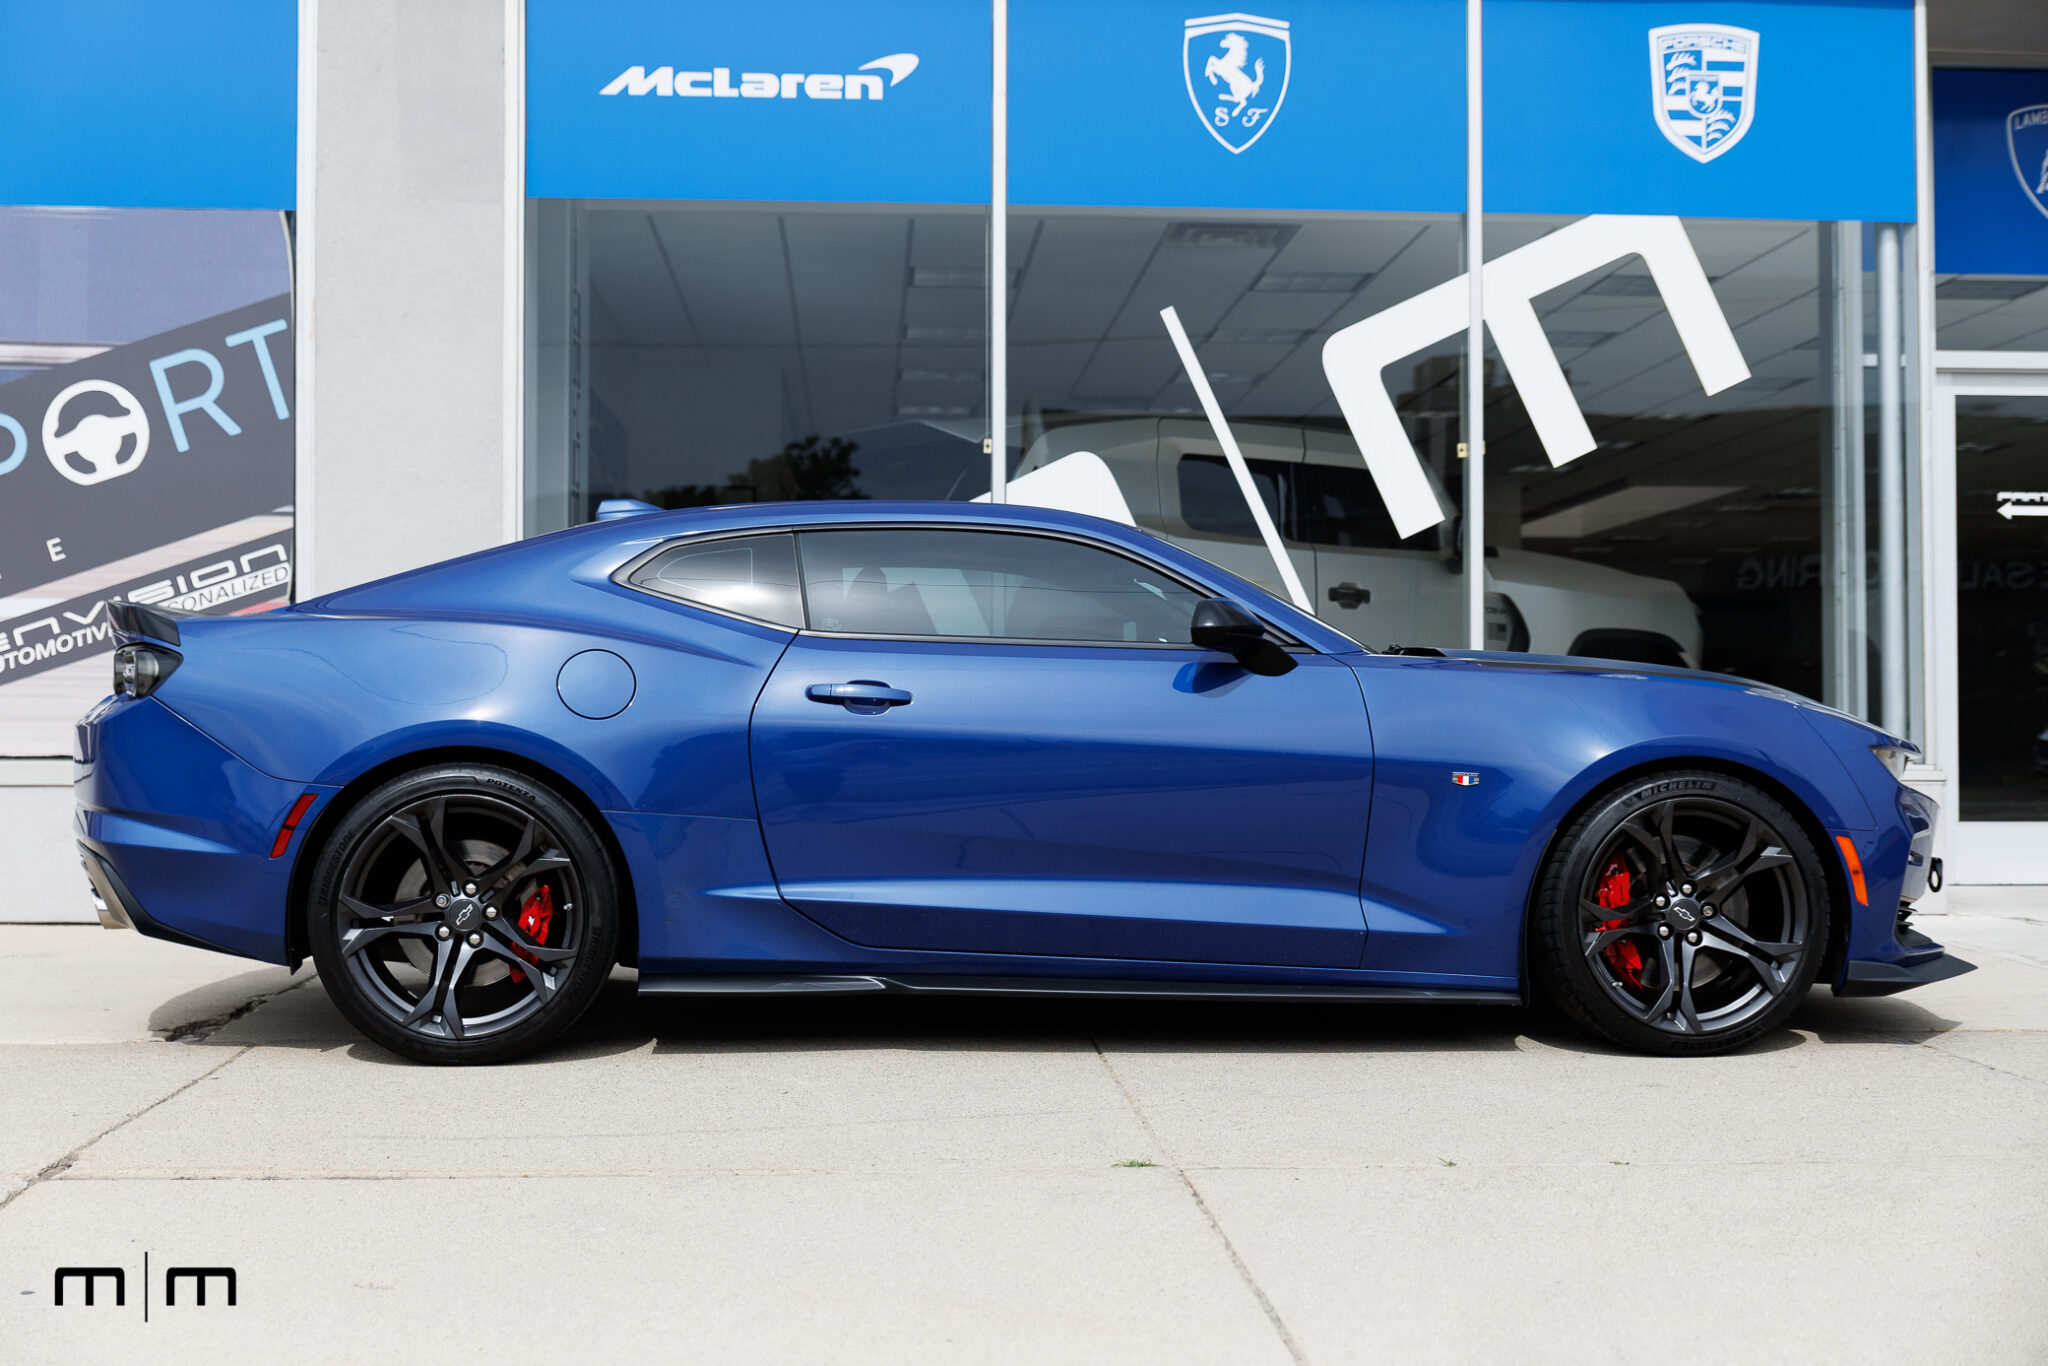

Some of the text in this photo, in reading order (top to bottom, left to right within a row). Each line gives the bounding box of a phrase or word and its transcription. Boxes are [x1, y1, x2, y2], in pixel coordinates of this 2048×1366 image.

[599, 65, 884, 100] McLaren
[1214, 106, 1269, 128] S F
[486, 777, 538, 802] POTENZA
